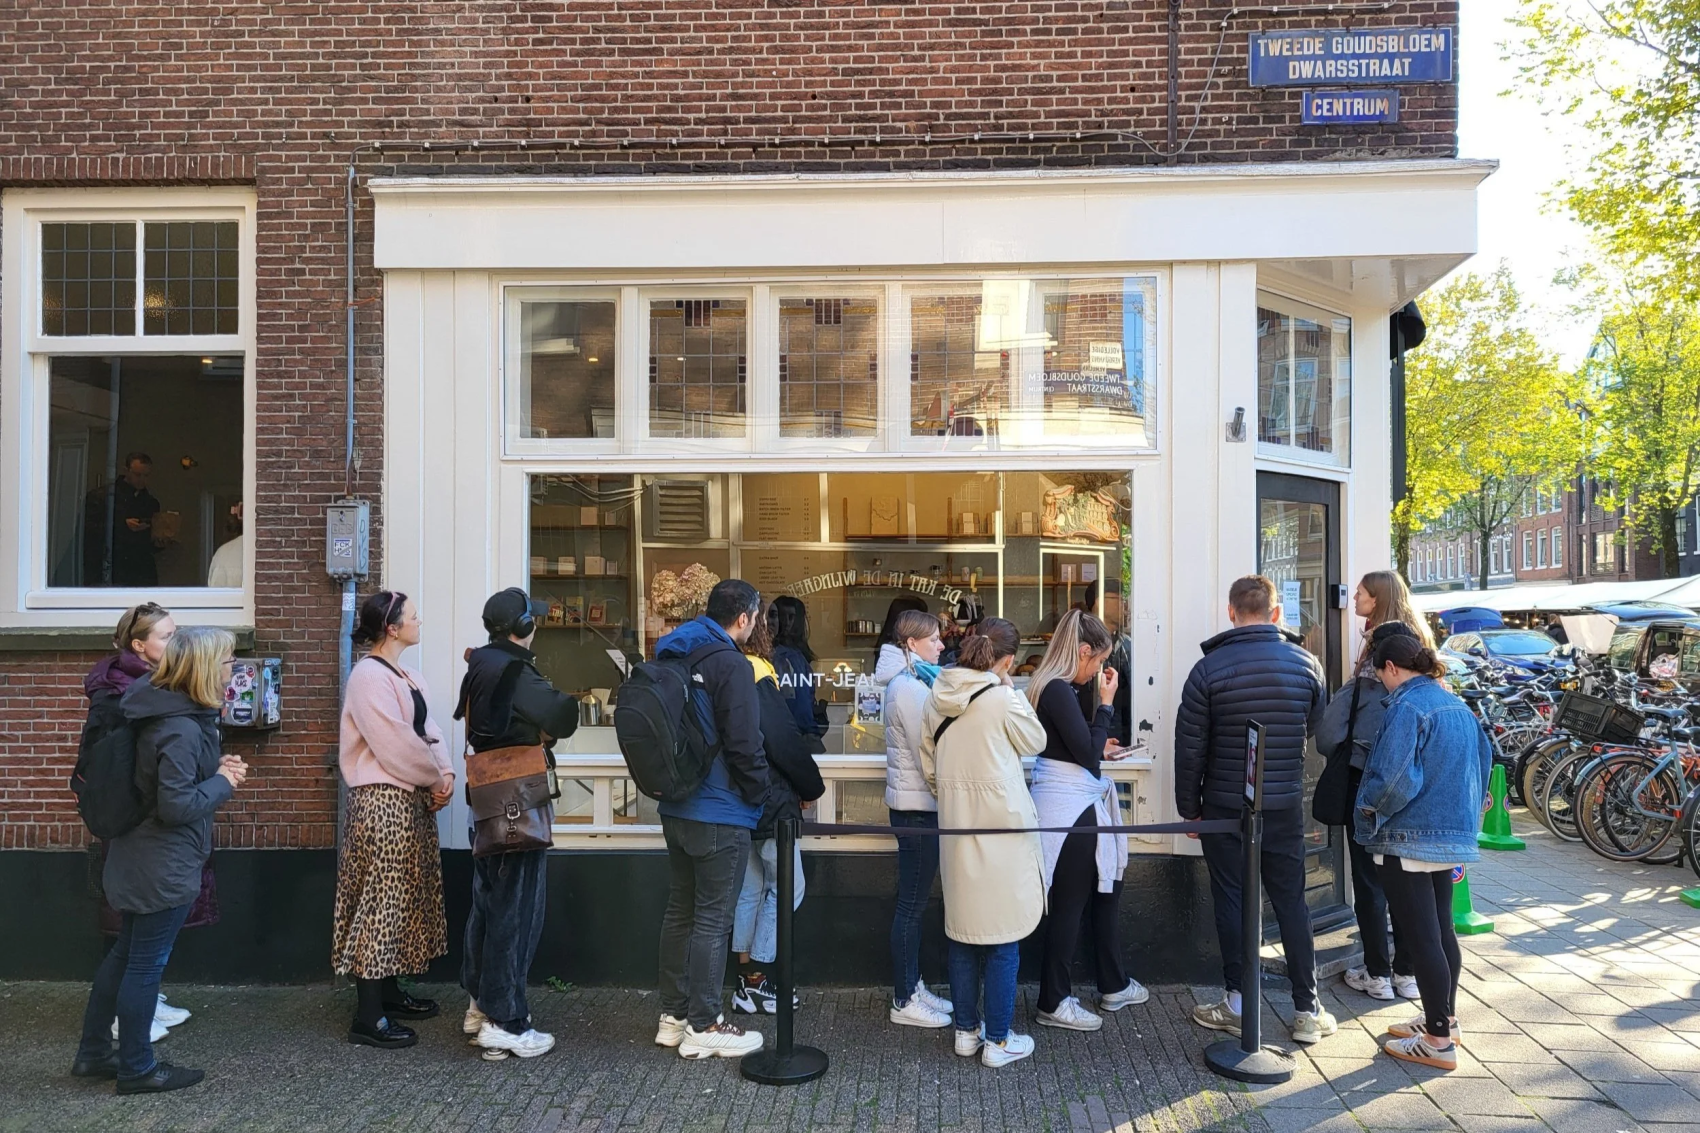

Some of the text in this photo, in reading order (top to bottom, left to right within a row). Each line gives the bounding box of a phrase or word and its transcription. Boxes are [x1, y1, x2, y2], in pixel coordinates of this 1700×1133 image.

[1257, 33, 1445, 57] TWEEDE GOUDSBLOEM
[1288, 58, 1412, 80] DWARSSTRAAT
[1311, 98, 1389, 117] CENTRUM
